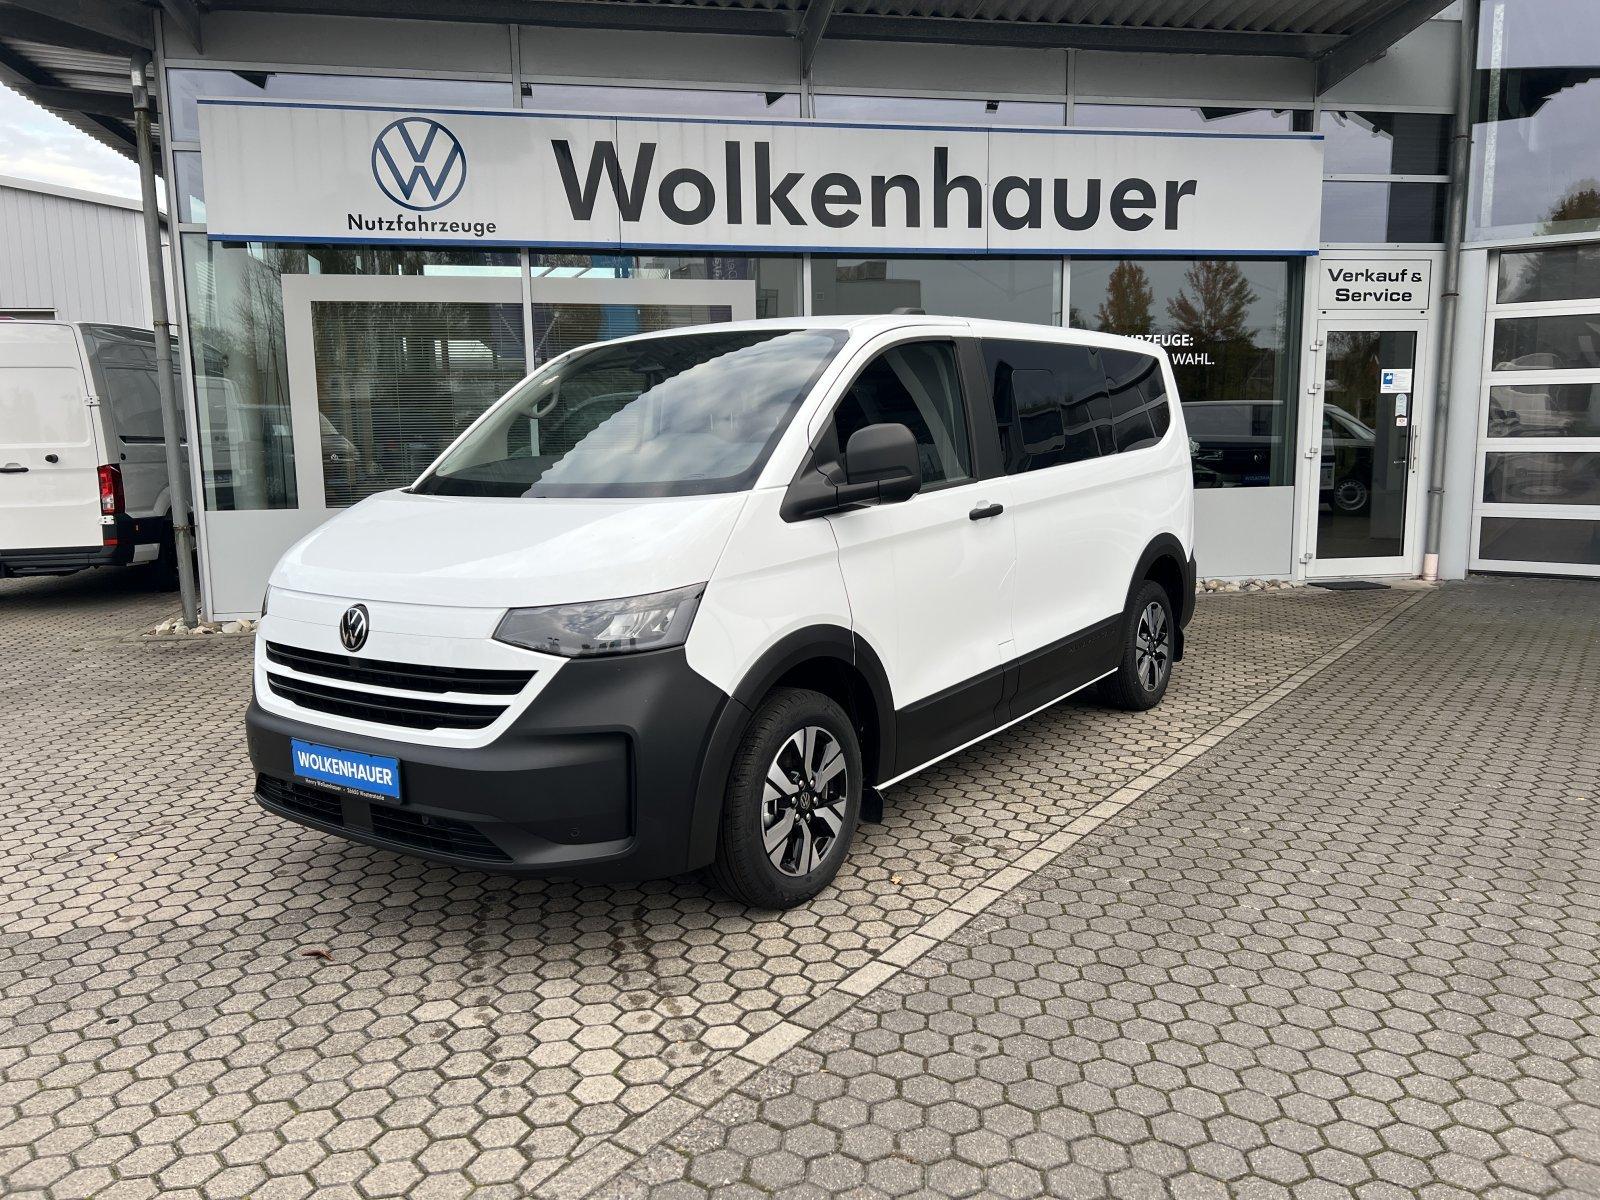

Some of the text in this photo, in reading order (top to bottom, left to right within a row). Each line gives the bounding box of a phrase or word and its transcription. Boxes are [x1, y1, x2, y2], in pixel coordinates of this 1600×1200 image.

[372, 117, 466, 210] VW
[551, 139, 1197, 232] Wolkenhauer
[347, 213, 497, 237] Nutzfahrzeuge
[1327, 268, 1422, 282] Verkauf &
[1335, 288, 1412, 302] Service
[1172, 352, 1215, 365] WAHL.
[297, 750, 393, 786] WOLKENHAUER
